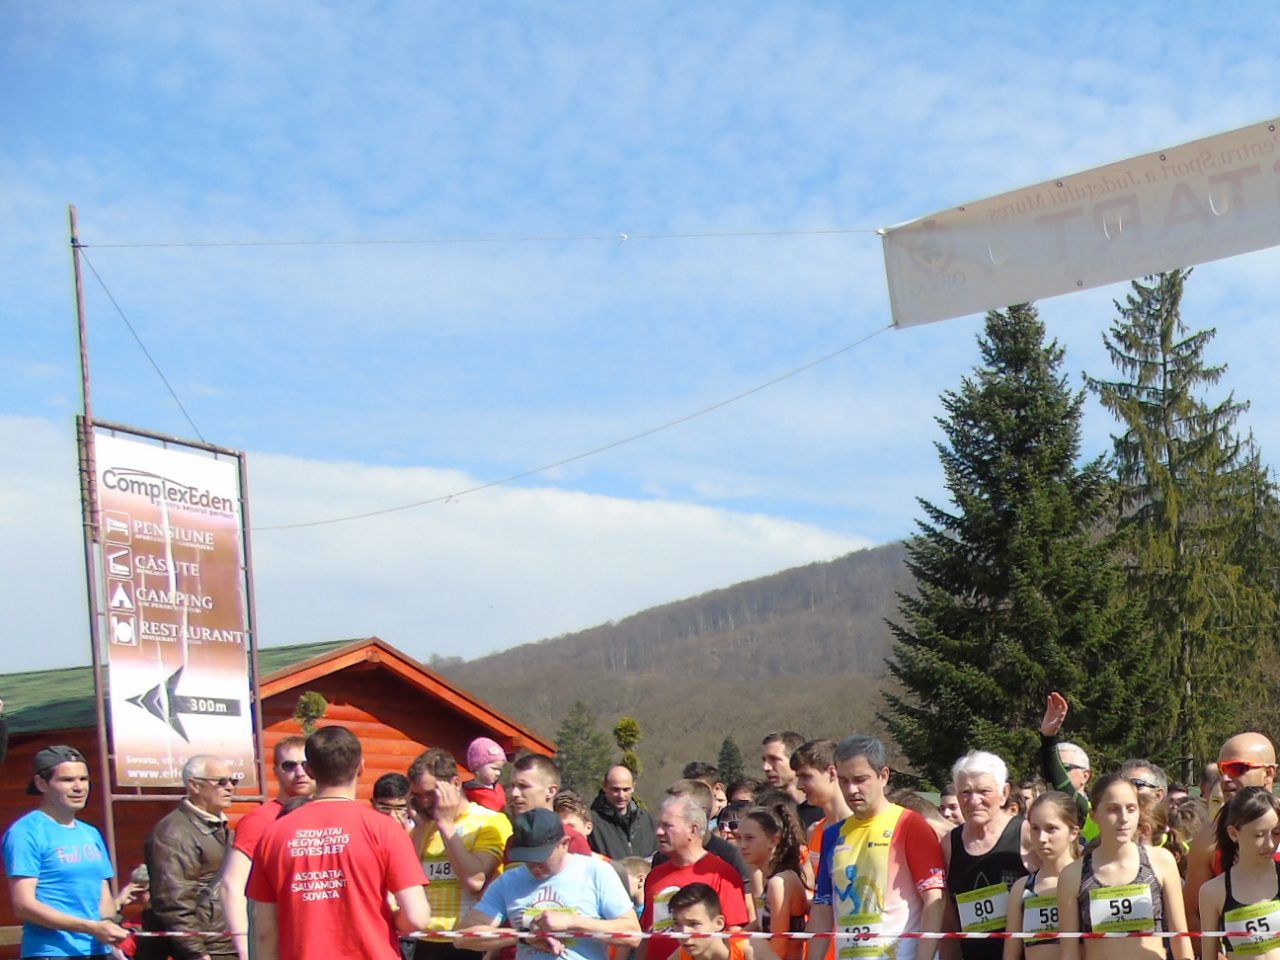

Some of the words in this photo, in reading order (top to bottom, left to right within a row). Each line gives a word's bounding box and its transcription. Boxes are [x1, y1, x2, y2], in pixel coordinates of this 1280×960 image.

[102, 468, 233, 512] ComplexEden
[133, 519, 214, 546] PENSIUNE
[136, 587, 213, 609] CAMPING
[141, 620, 244, 643] RESTAURANT
[189, 698, 227, 713] 300m
[429, 862, 451, 876] 148
[303, 890, 340, 902] SOVATA
[974, 899, 994, 918] 80
[1039, 907, 1059, 924] 58
[1109, 898, 1133, 916] 59
[1245, 917, 1271, 933] 65
